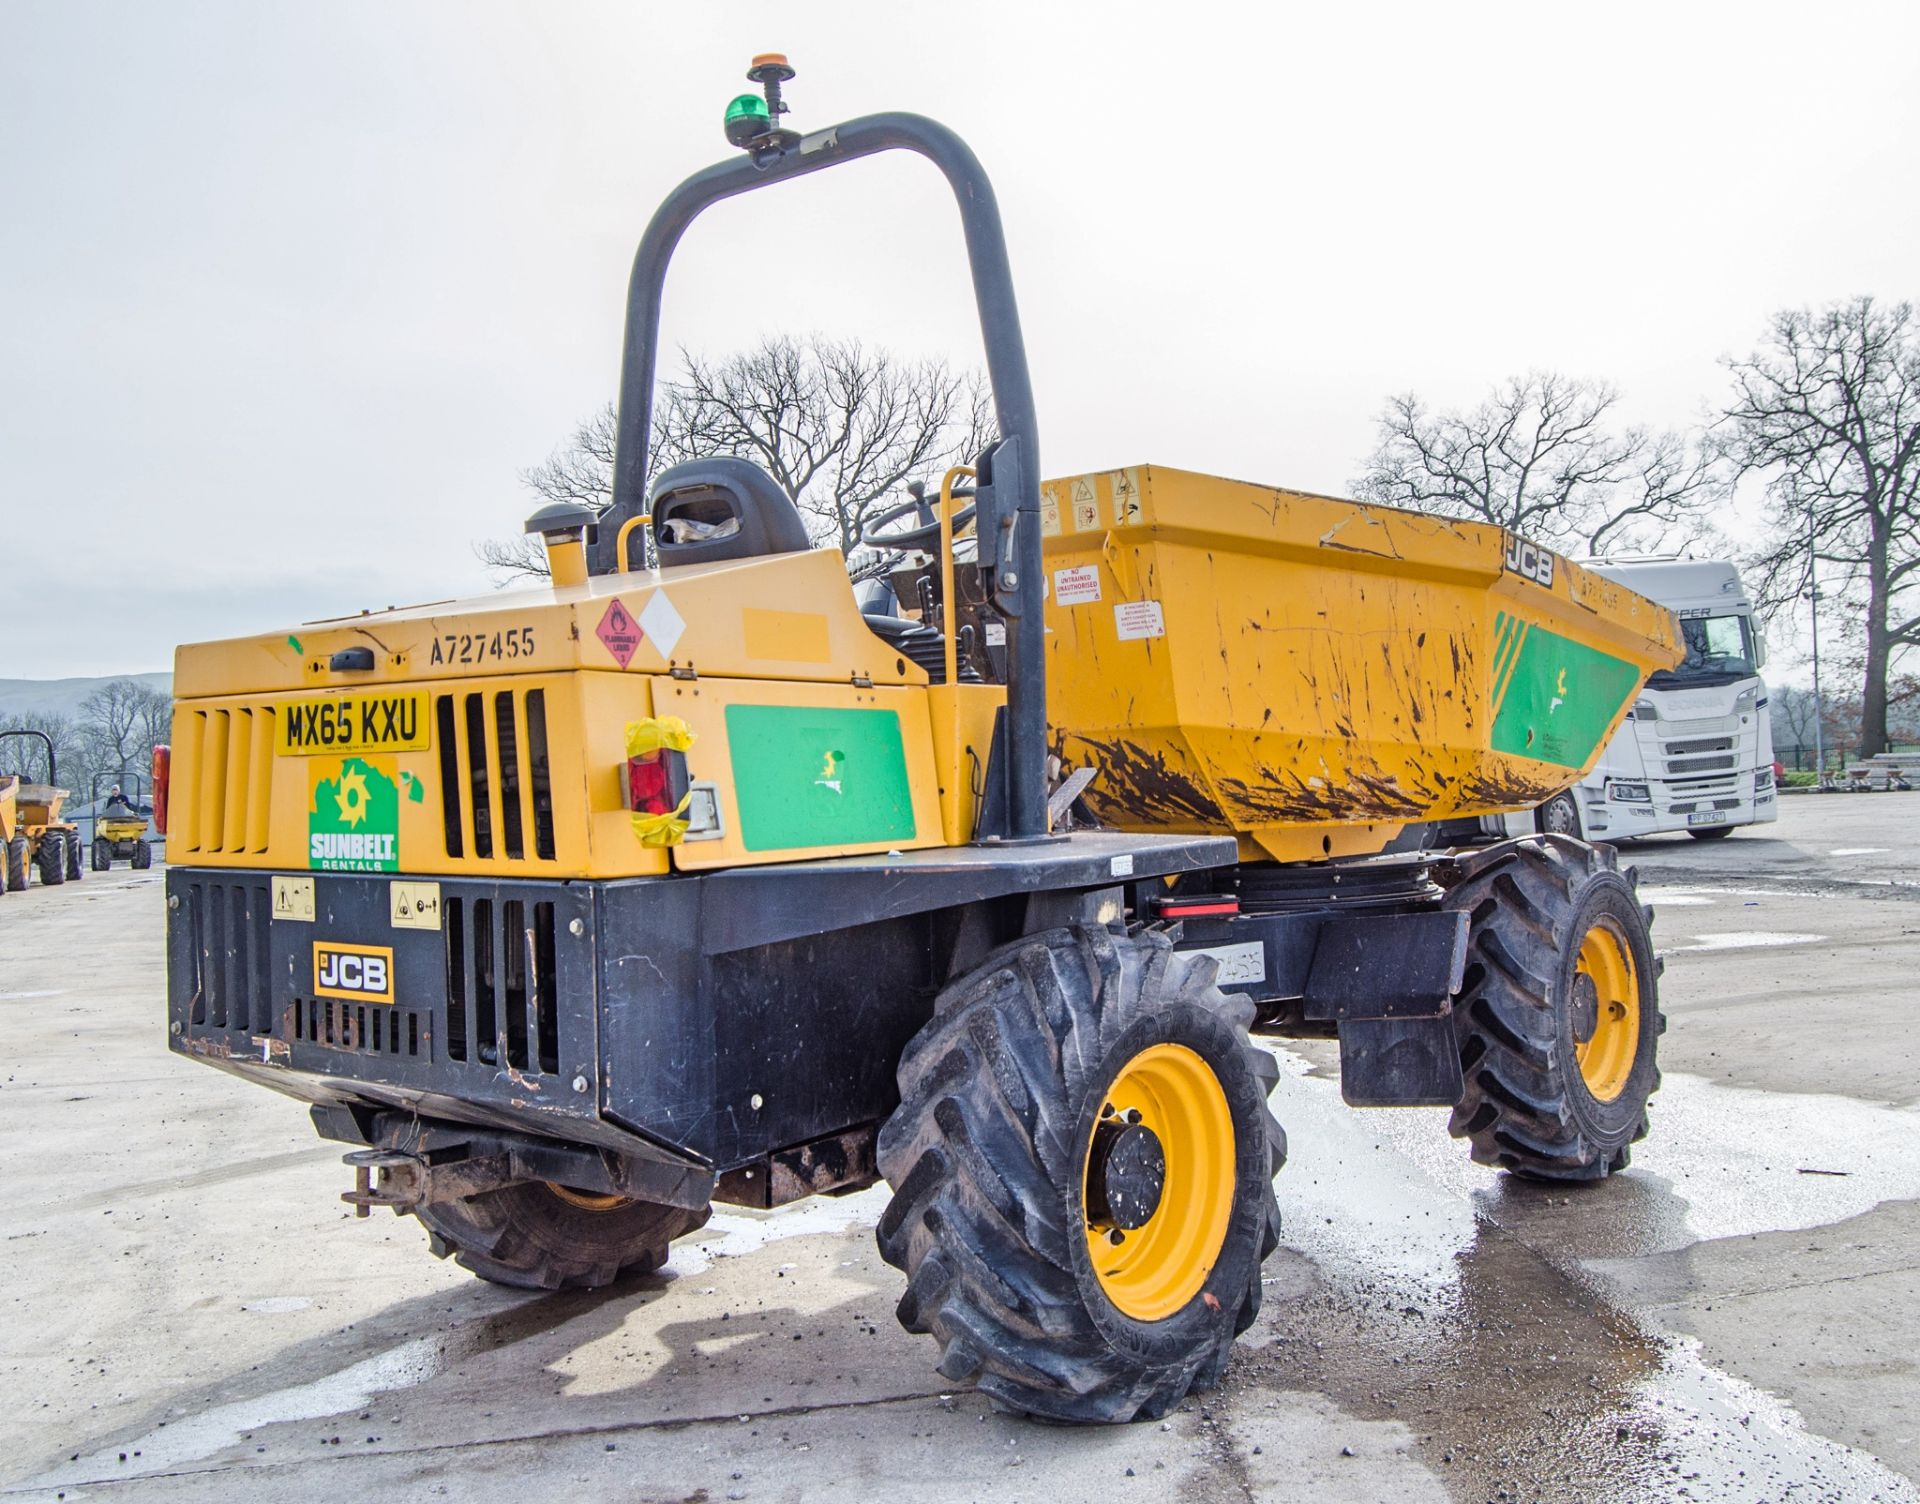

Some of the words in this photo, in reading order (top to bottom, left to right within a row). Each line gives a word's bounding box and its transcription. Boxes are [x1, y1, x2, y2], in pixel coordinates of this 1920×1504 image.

[1507, 540, 1553, 585] JCB
[1056, 581, 1098, 592] UNAUTHORISED
[1061, 575, 1091, 584] UNTRAINED
[431, 627, 534, 666] A727455
[604, 635, 636, 644] FLAMMABLE
[613, 644, 630, 652] LIQUID
[287, 700, 353, 747] MX65
[362, 697, 417, 743] KXU
[311, 832, 394, 861] SUNBELT
[322, 860, 383, 872] RENTALS
[320, 954, 387, 991] JCB
